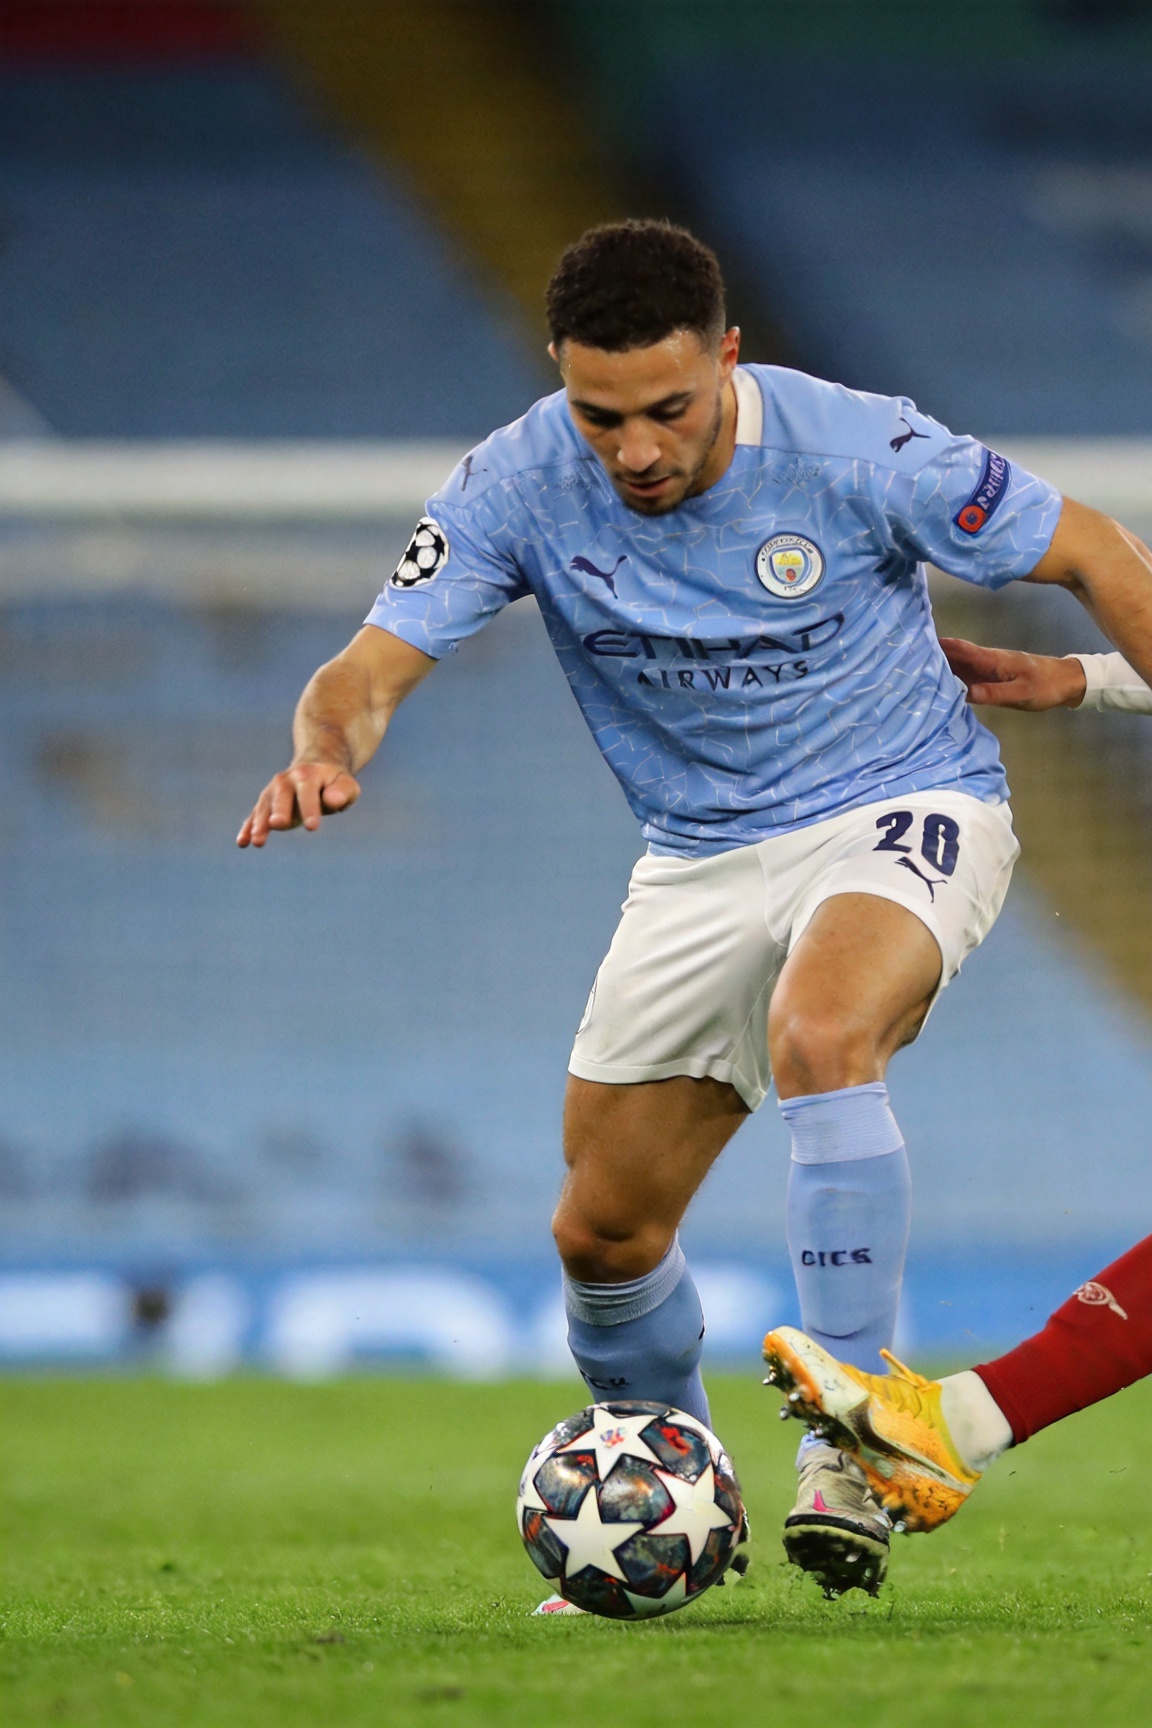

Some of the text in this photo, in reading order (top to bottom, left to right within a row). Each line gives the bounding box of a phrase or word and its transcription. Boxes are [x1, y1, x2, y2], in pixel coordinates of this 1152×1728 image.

[583, 613, 845, 660] ETIHAD
[637, 660, 808, 691] AIRWAYS
[872, 811, 960, 877] 20
